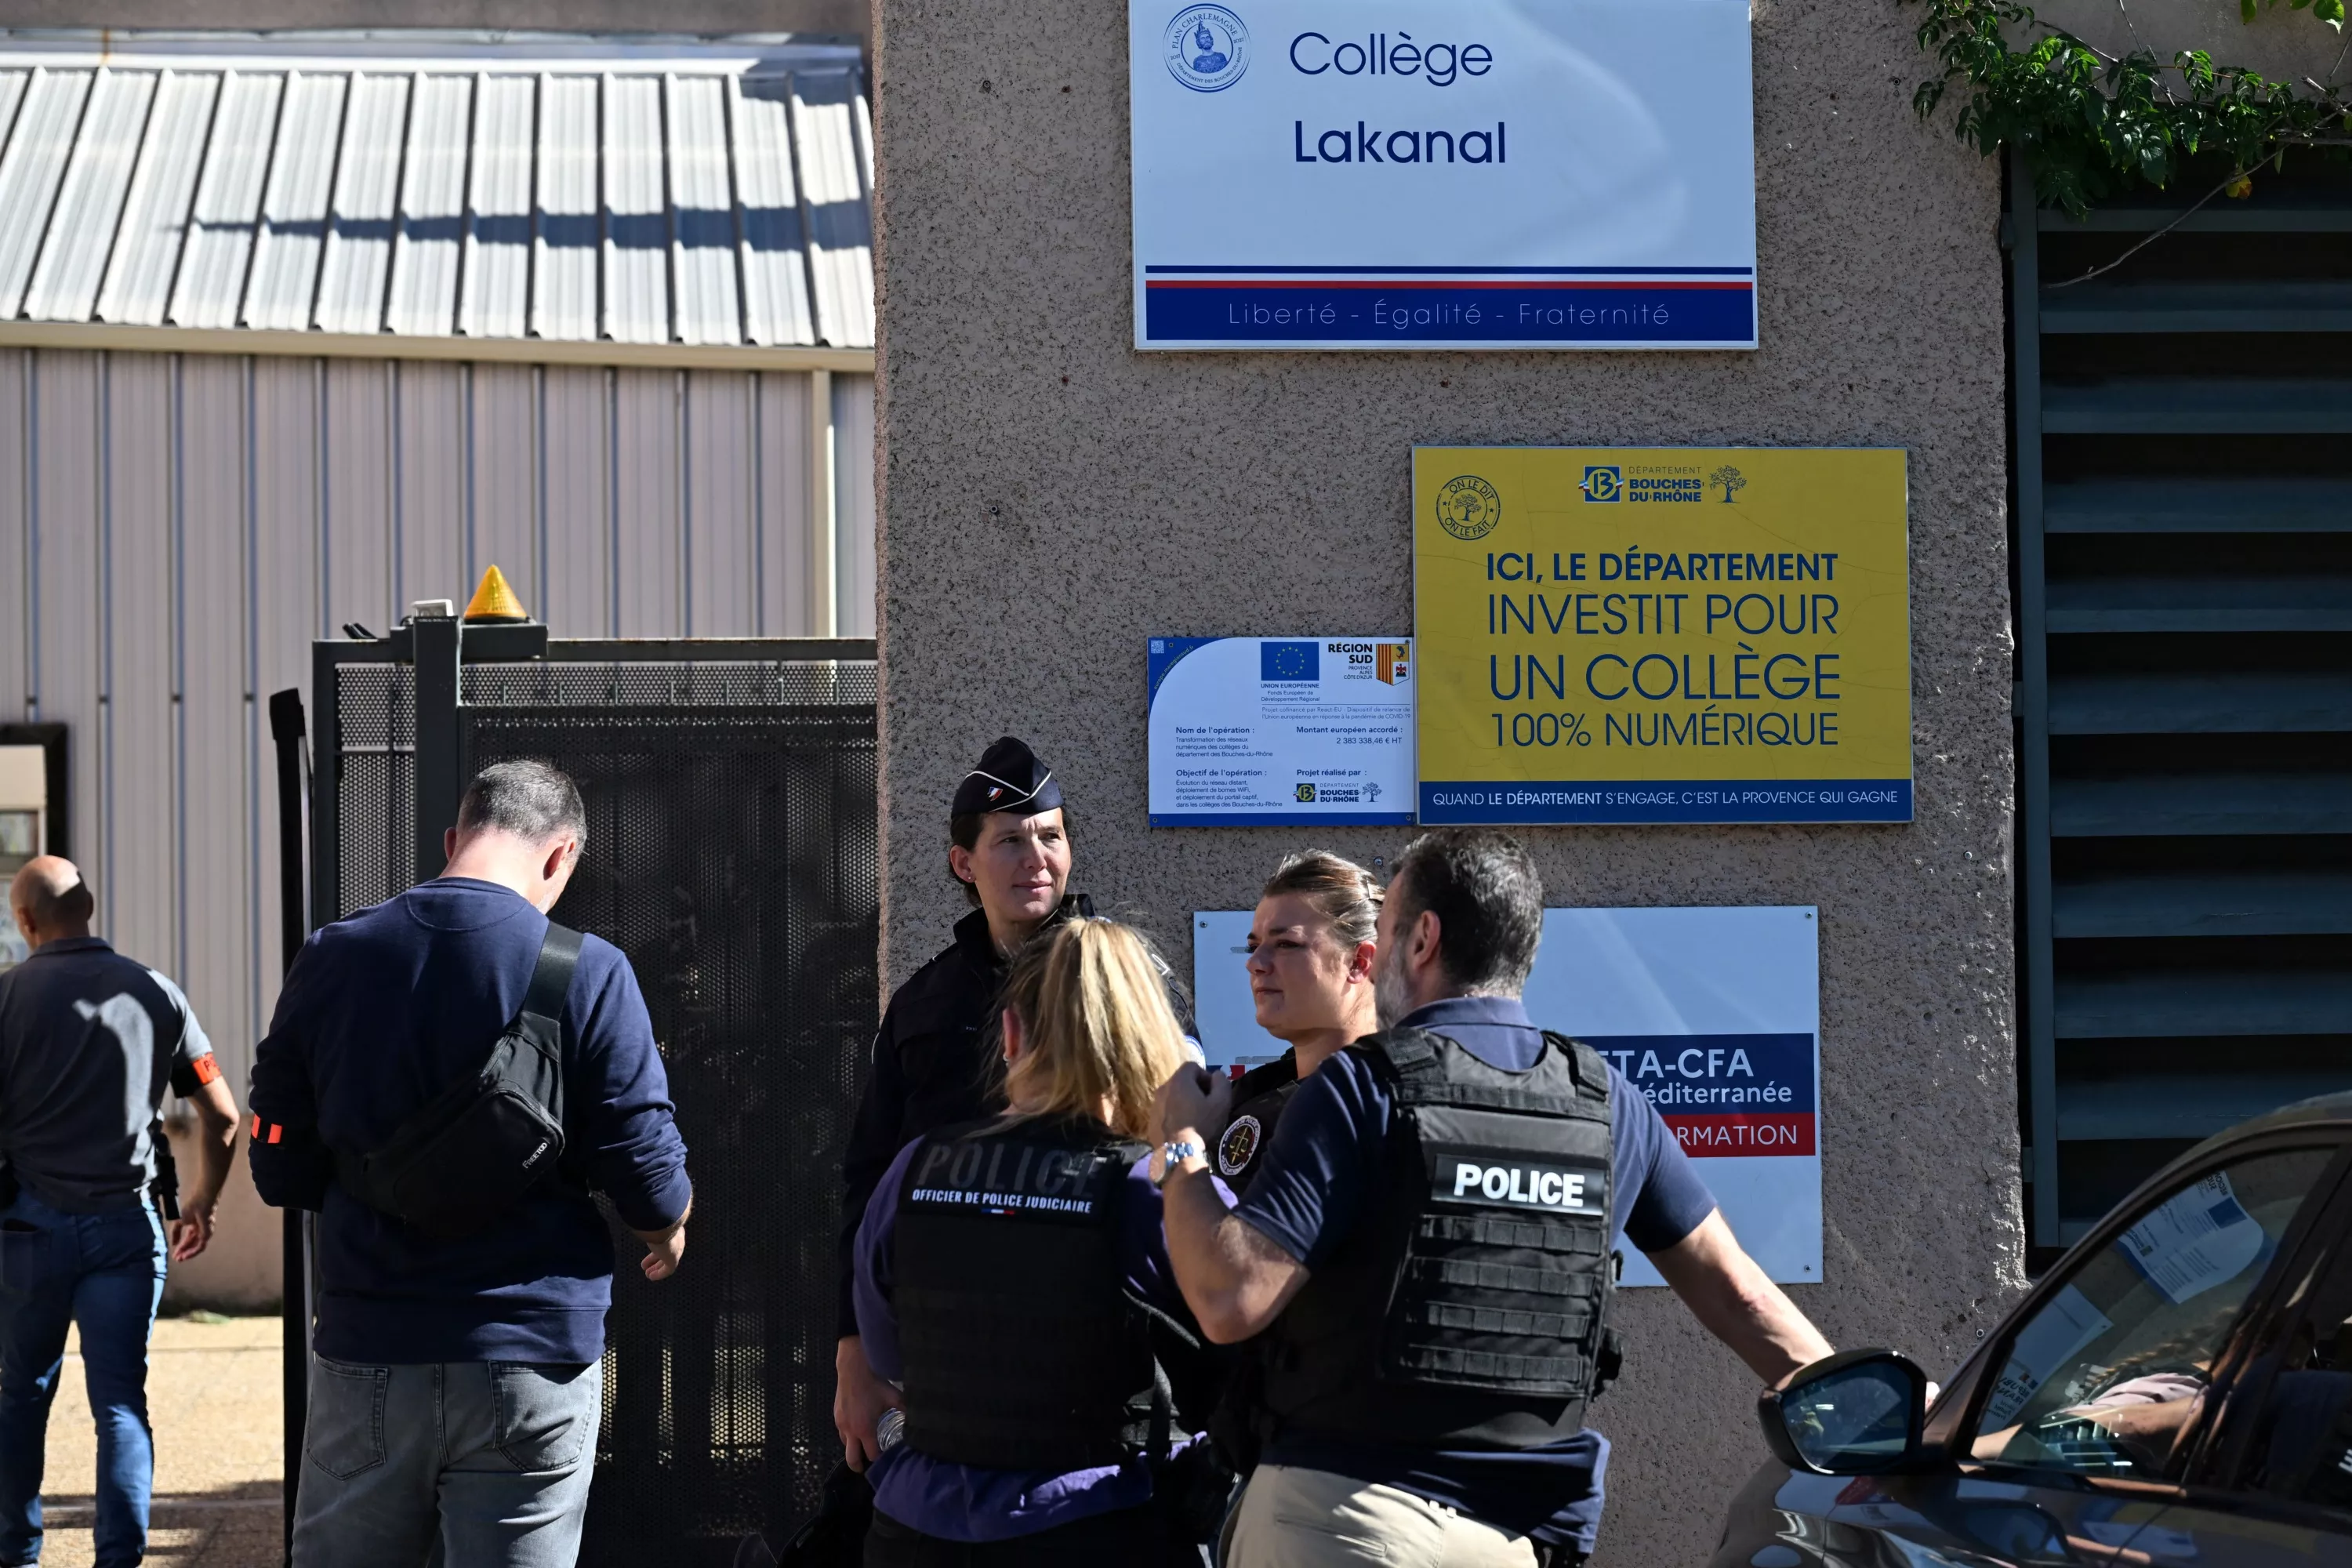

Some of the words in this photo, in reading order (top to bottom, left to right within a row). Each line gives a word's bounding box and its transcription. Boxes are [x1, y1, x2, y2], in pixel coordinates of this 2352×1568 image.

[1171, 28, 1183, 49] PLAN
[1181, 13, 1238, 36] CHARLEMAGNE
[1290, 31, 1494, 86] Collège
[1295, 121, 1507, 164] Lakanal
[1229, 303, 1336, 325] Liberté
[1374, 299, 1482, 330] Égalité
[1519, 303, 1669, 325] Fraternité
[1628, 466, 1702, 474] DÉPARTEMENT
[1449, 480, 1465, 493] ON
[1468, 480, 1479, 489] LE
[1479, 485, 1495, 500] DIT
[1593, 472, 1614, 498] 13
[1445, 517, 1459, 532] ON
[1460, 528, 1470, 536] LE
[1472, 520, 1490, 535] FAIT
[1487, 553, 1544, 584] ICI,
[1553, 553, 1586, 582] LE
[1599, 545, 1838, 582] DÉPARTEMENT
[1489, 594, 1689, 635] INVESTIT
[1707, 593, 1839, 635] POUR
[1327, 642, 1373, 652] RÉGION
[1348, 655, 1373, 663] SUD
[1490, 654, 1565, 701] UN
[1585, 641, 1841, 701] COLLÈGE
[1491, 713, 1592, 747] 100%
[1606, 704, 1838, 746] NUMÉRIQUE
[1176, 769, 1207, 778] Objectif
[1221, 769, 1262, 778] l'opération
[1301, 786, 1312, 800] 13
[1433, 793, 1484, 805] QUAND
[1489, 793, 1502, 805] LE
[1507, 789, 1602, 805] DÉPARTEMENT
[1606, 792, 1679, 805] S'ENGAGE,
[1682, 792, 1719, 804] C'EST
[1723, 792, 1739, 804] LA
[1743, 791, 1816, 804] PROVENCE
[1820, 791, 1843, 804] QUI
[1848, 791, 1898, 804] GAGNE
[1598, 1048, 1755, 1079] TA-CFA
[1633, 1080, 1792, 1105] éditerranée
[916, 1142, 1102, 1198] POLICE
[1454, 1163, 1584, 1207] POLICE
[912, 1189, 962, 1203] OFFICIER
[965, 1191, 979, 1204] DE
[982, 1192, 1022, 1207] POLICE
[1025, 1195, 1093, 1214] JUDICIAIRE
